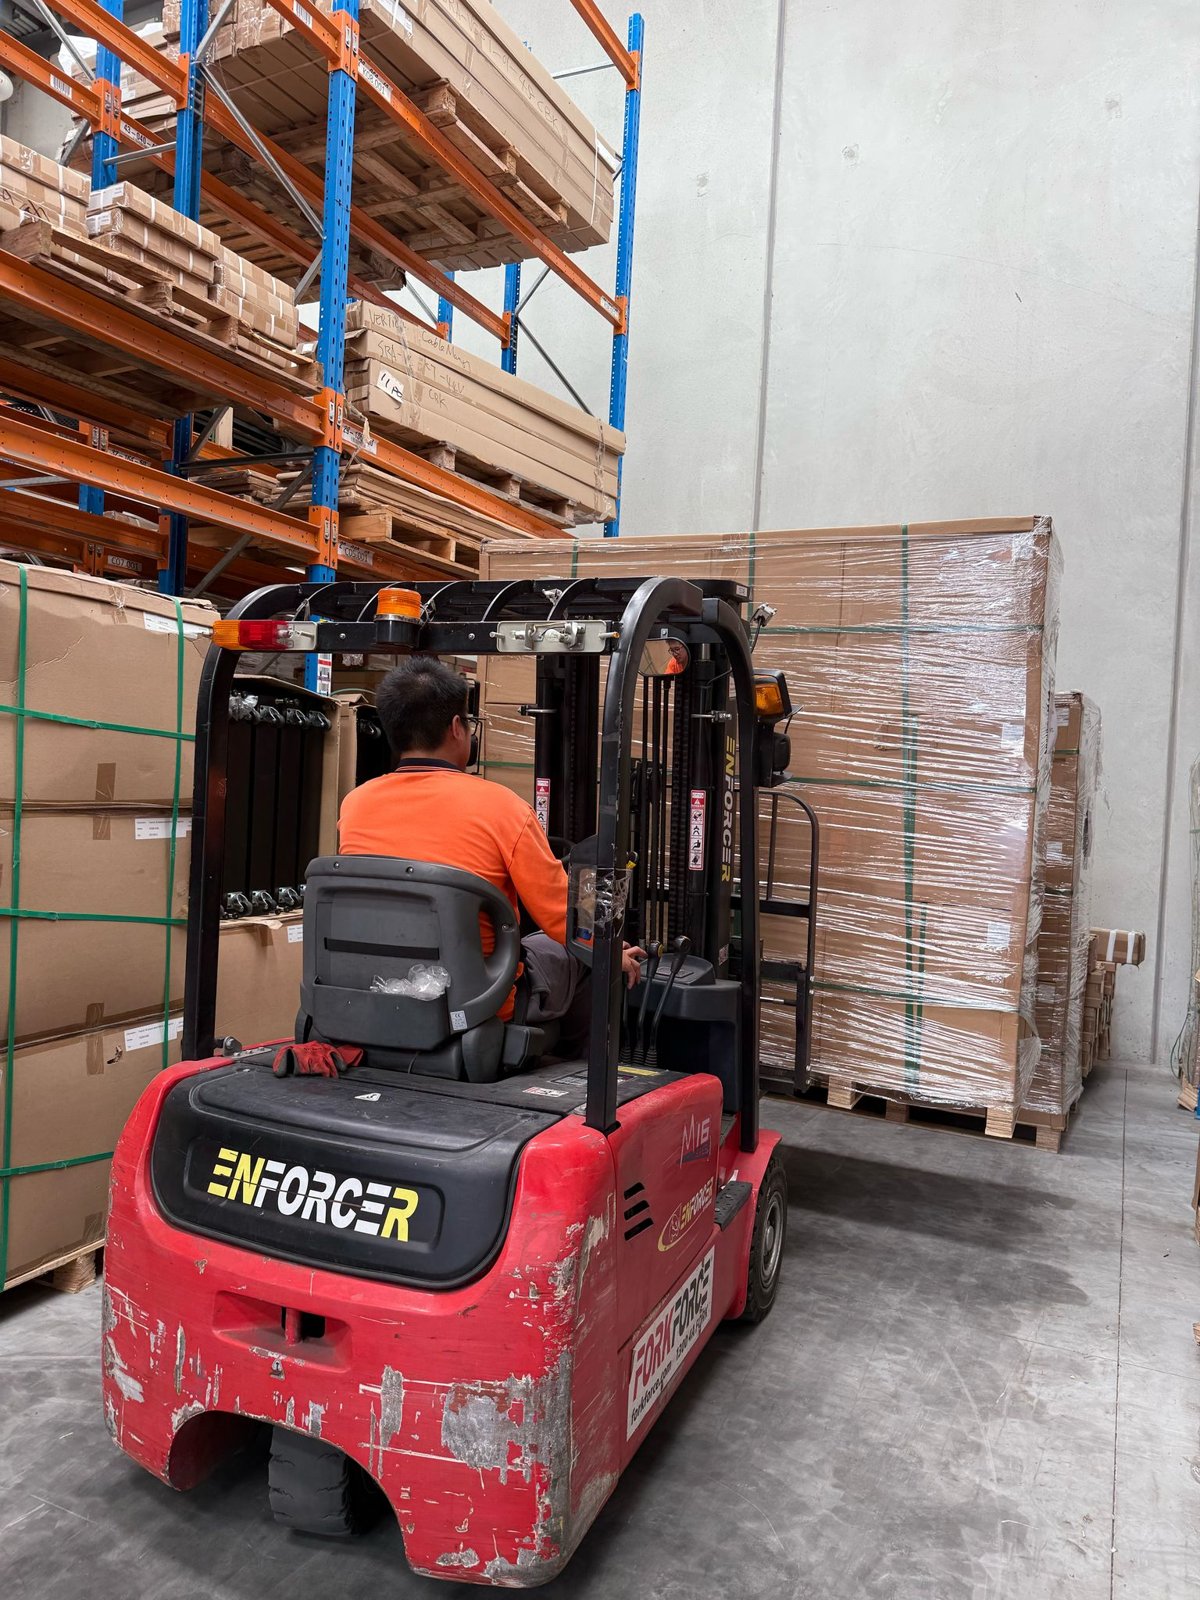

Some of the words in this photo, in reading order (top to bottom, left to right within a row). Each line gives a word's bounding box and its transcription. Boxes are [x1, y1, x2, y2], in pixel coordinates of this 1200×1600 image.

[720, 735, 736, 883] ENFORCER
[207, 1147, 419, 1242] ENFORCER
[680, 1176, 714, 1232] ENFORCER
[633, 1258, 712, 1400] FORKFORCE
[630, 1361, 673, 1428] forkforce.com
